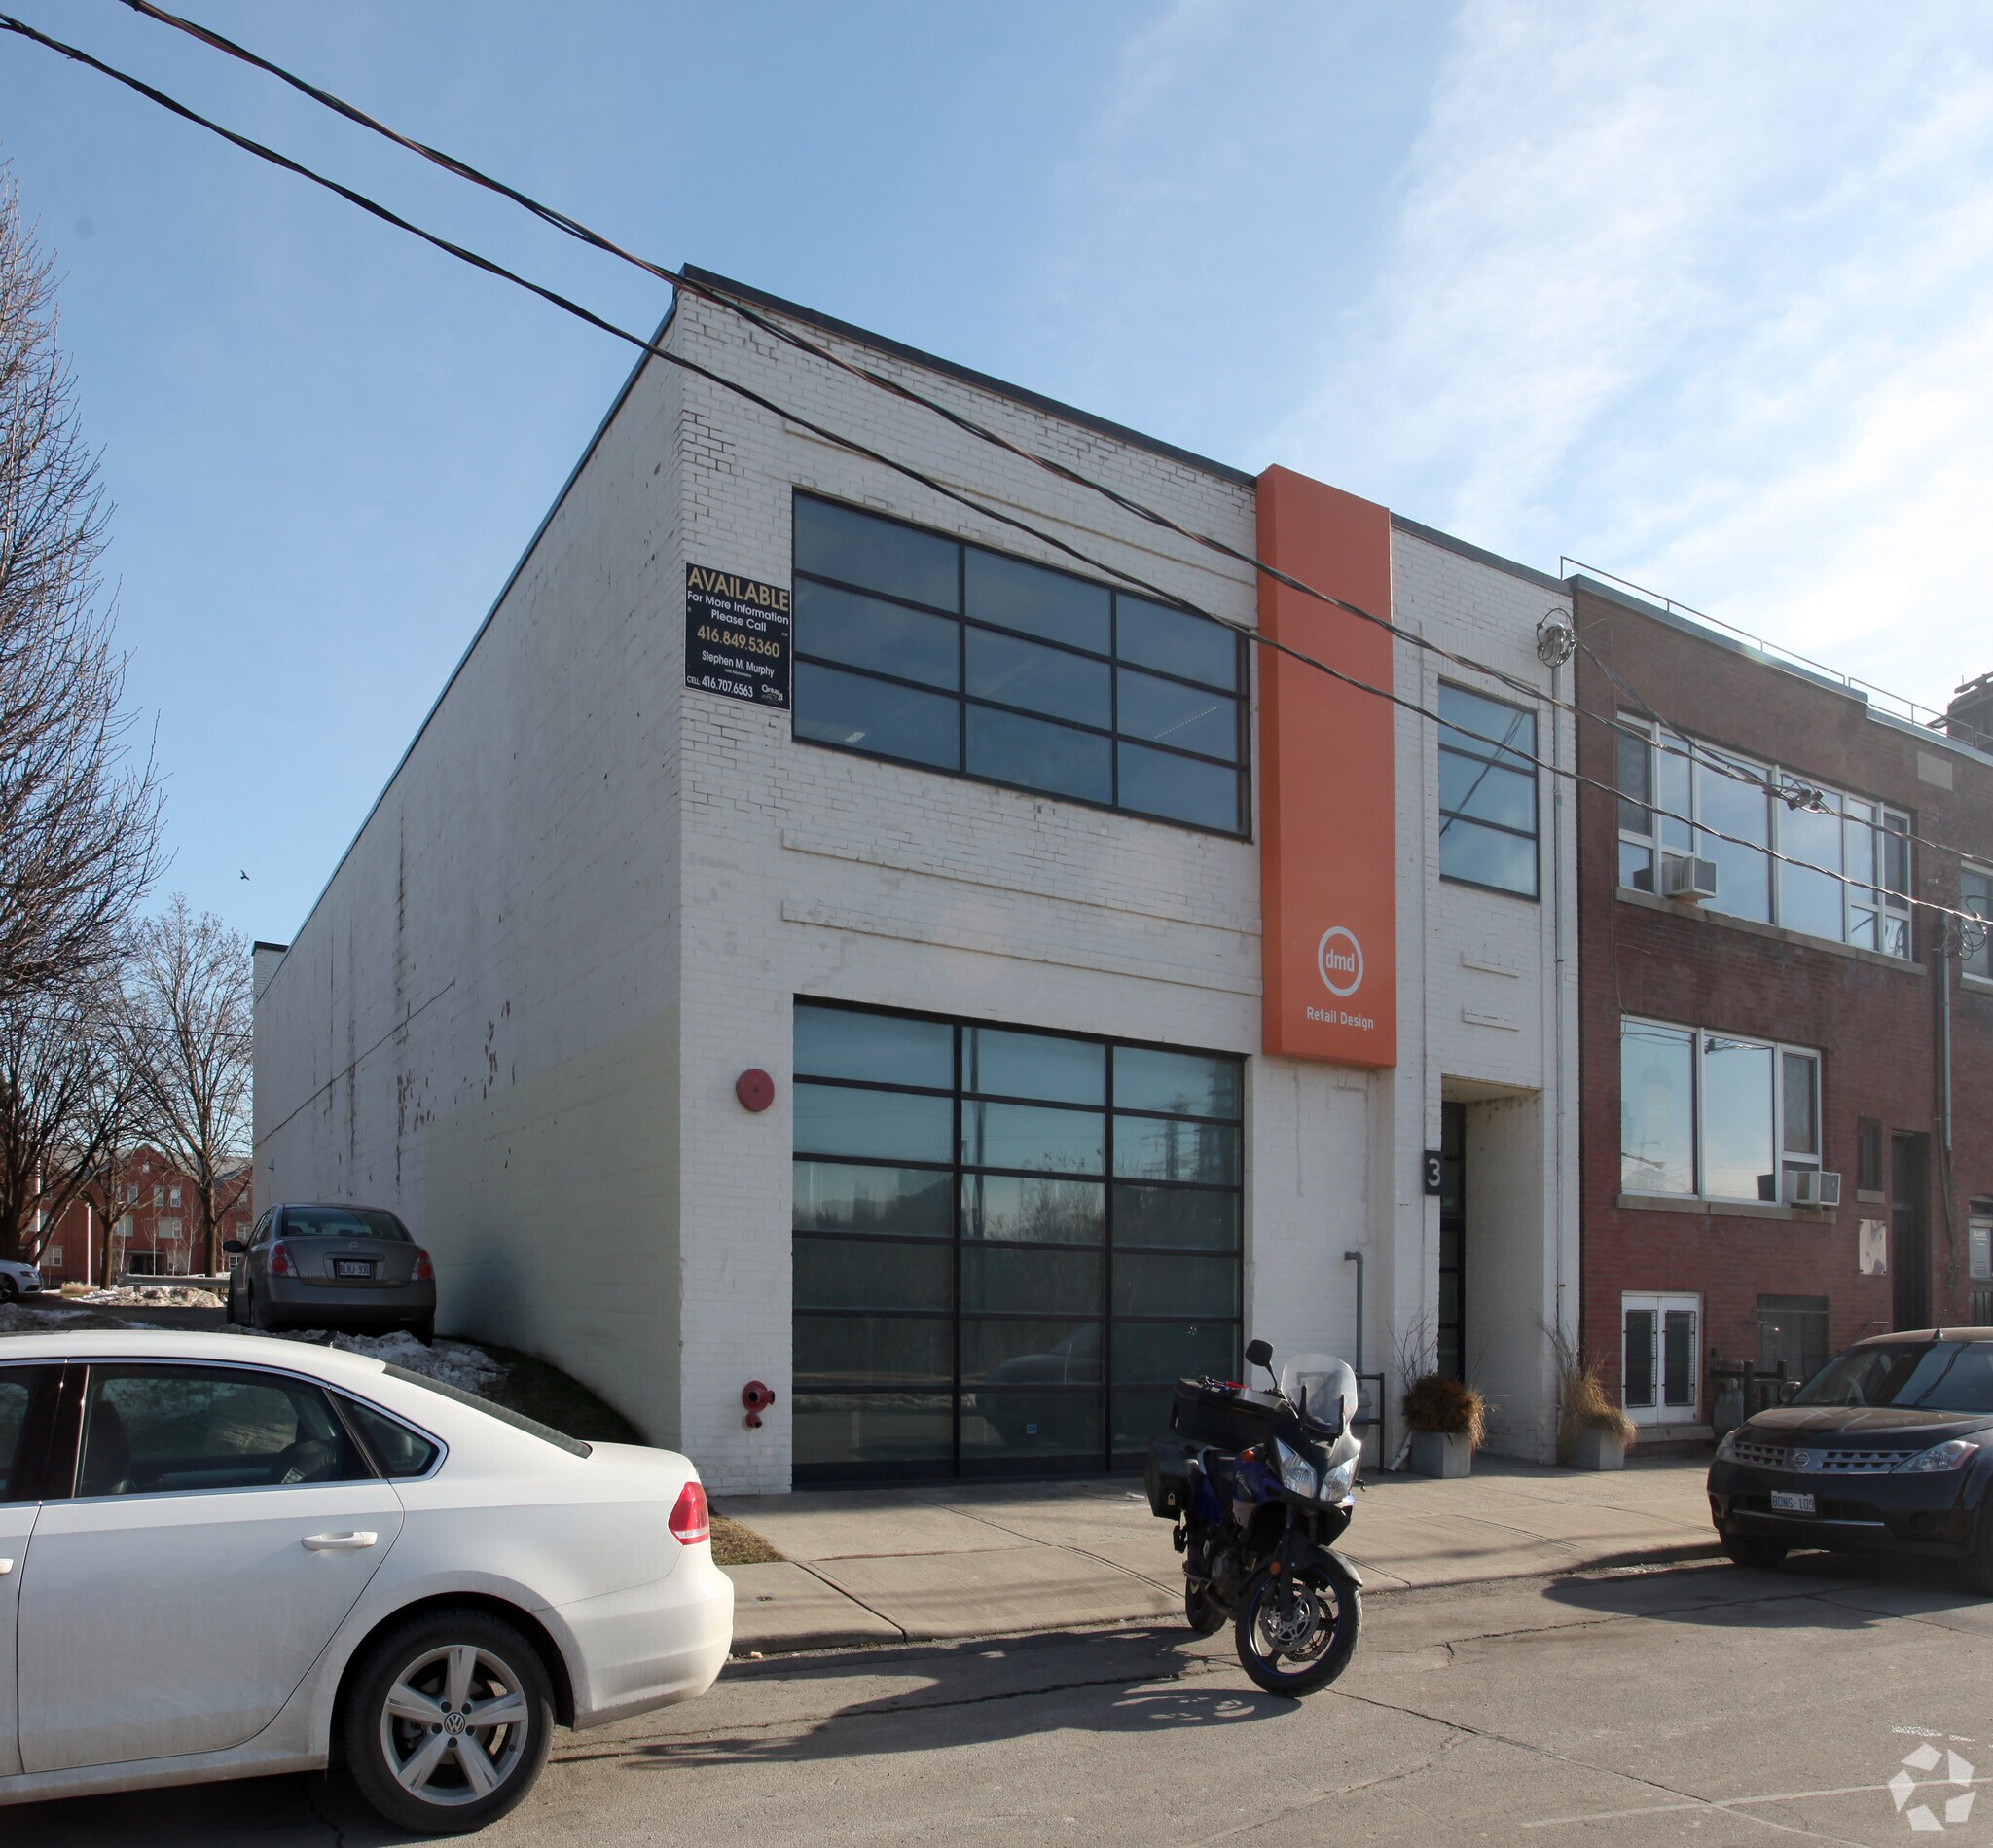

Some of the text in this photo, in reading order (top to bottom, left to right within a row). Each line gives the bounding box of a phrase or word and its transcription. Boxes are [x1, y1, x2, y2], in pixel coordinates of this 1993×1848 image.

[687, 567, 789, 612] AVAILABLE
[687, 590, 789, 625] For More Information
[711, 609, 767, 632] Please Call
[697, 625, 780, 658] 416.849.5360
[702, 650, 734, 668] Stephen
[735, 658, 745, 670] M.
[746, 661, 775, 678] Murphy
[701, 675, 754, 698] 416.707.6563
[1325, 949, 1355, 972] dmd
[1306, 1006, 1374, 1031] Retail Design
[1428, 1158, 1441, 1187] 3
